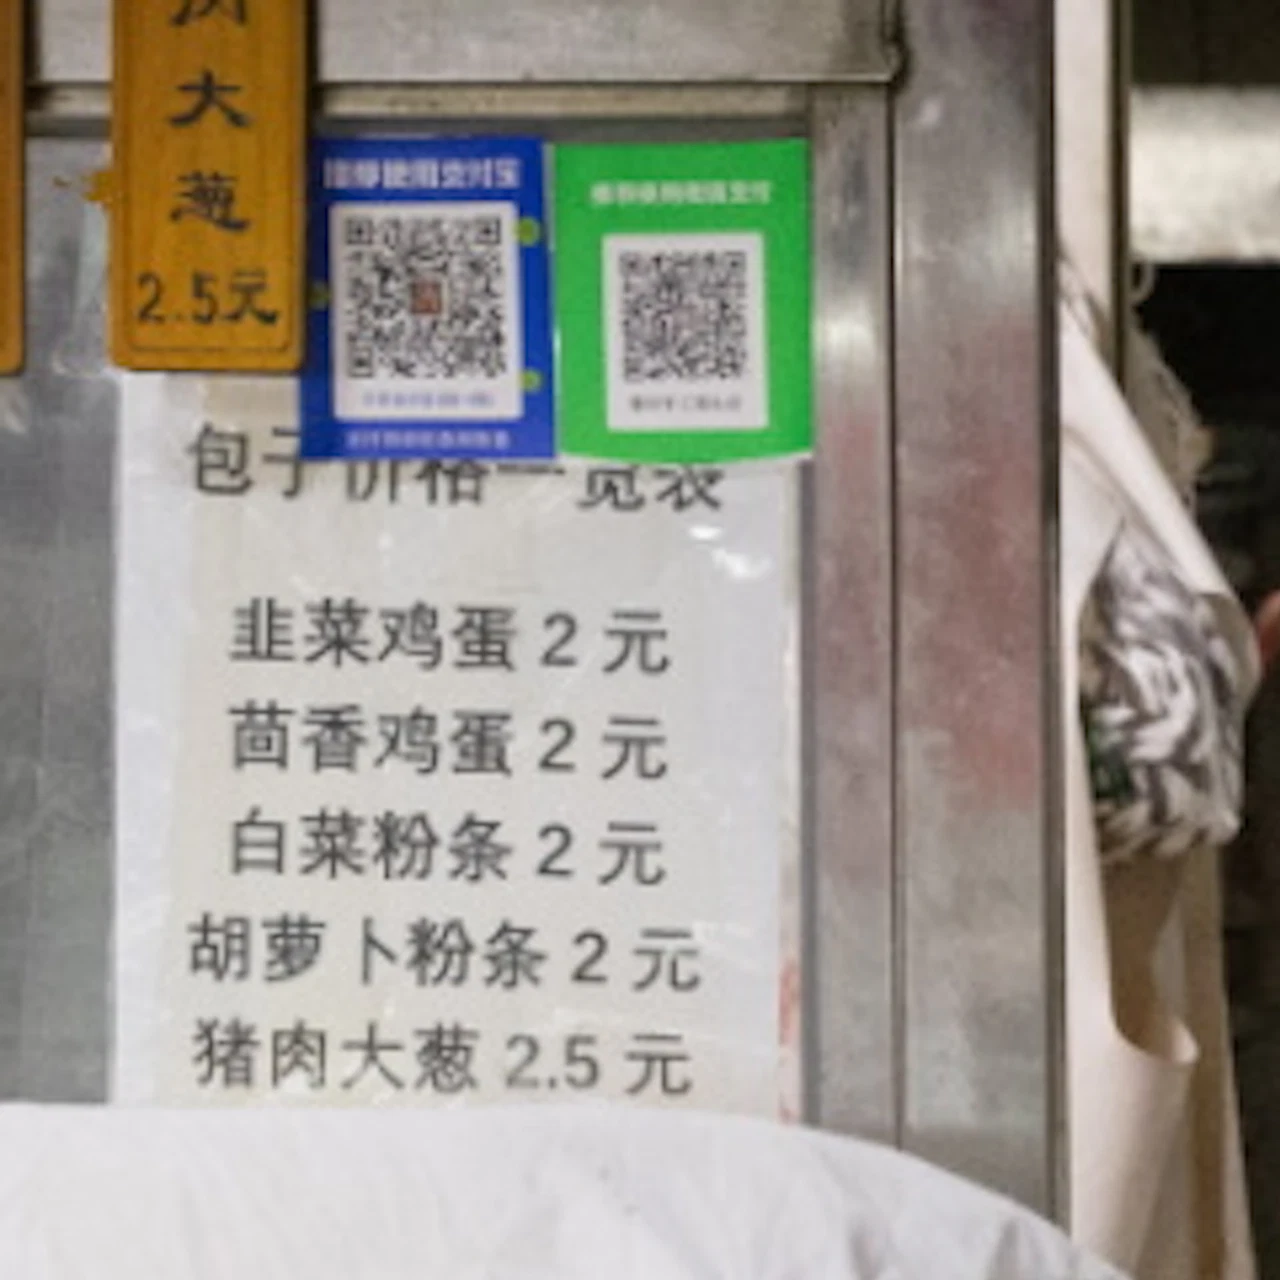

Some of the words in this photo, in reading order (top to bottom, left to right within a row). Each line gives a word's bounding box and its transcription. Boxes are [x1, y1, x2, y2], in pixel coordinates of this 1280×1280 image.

[137, 270, 279, 326] 2.5元
[228, 595, 518, 674] 韭菜鸡蛋
[538, 610, 579, 669] 2
[601, 609, 672, 677] 元
[226, 698, 514, 778] 茴香鸡蛋
[536, 716, 577, 774] 2
[599, 714, 669, 782] 元
[230, 805, 514, 885] 白菜粉条
[534, 821, 575, 880] 2
[597, 820, 668, 888] 元
[186, 910, 549, 992] 胡萝卜粉条
[569, 928, 610, 986] 2
[632, 927, 703, 994] 元
[191, 1016, 480, 1095] 猪肉大葱
[504, 1033, 602, 1091] 2.5
[624, 1032, 694, 1098] 元
